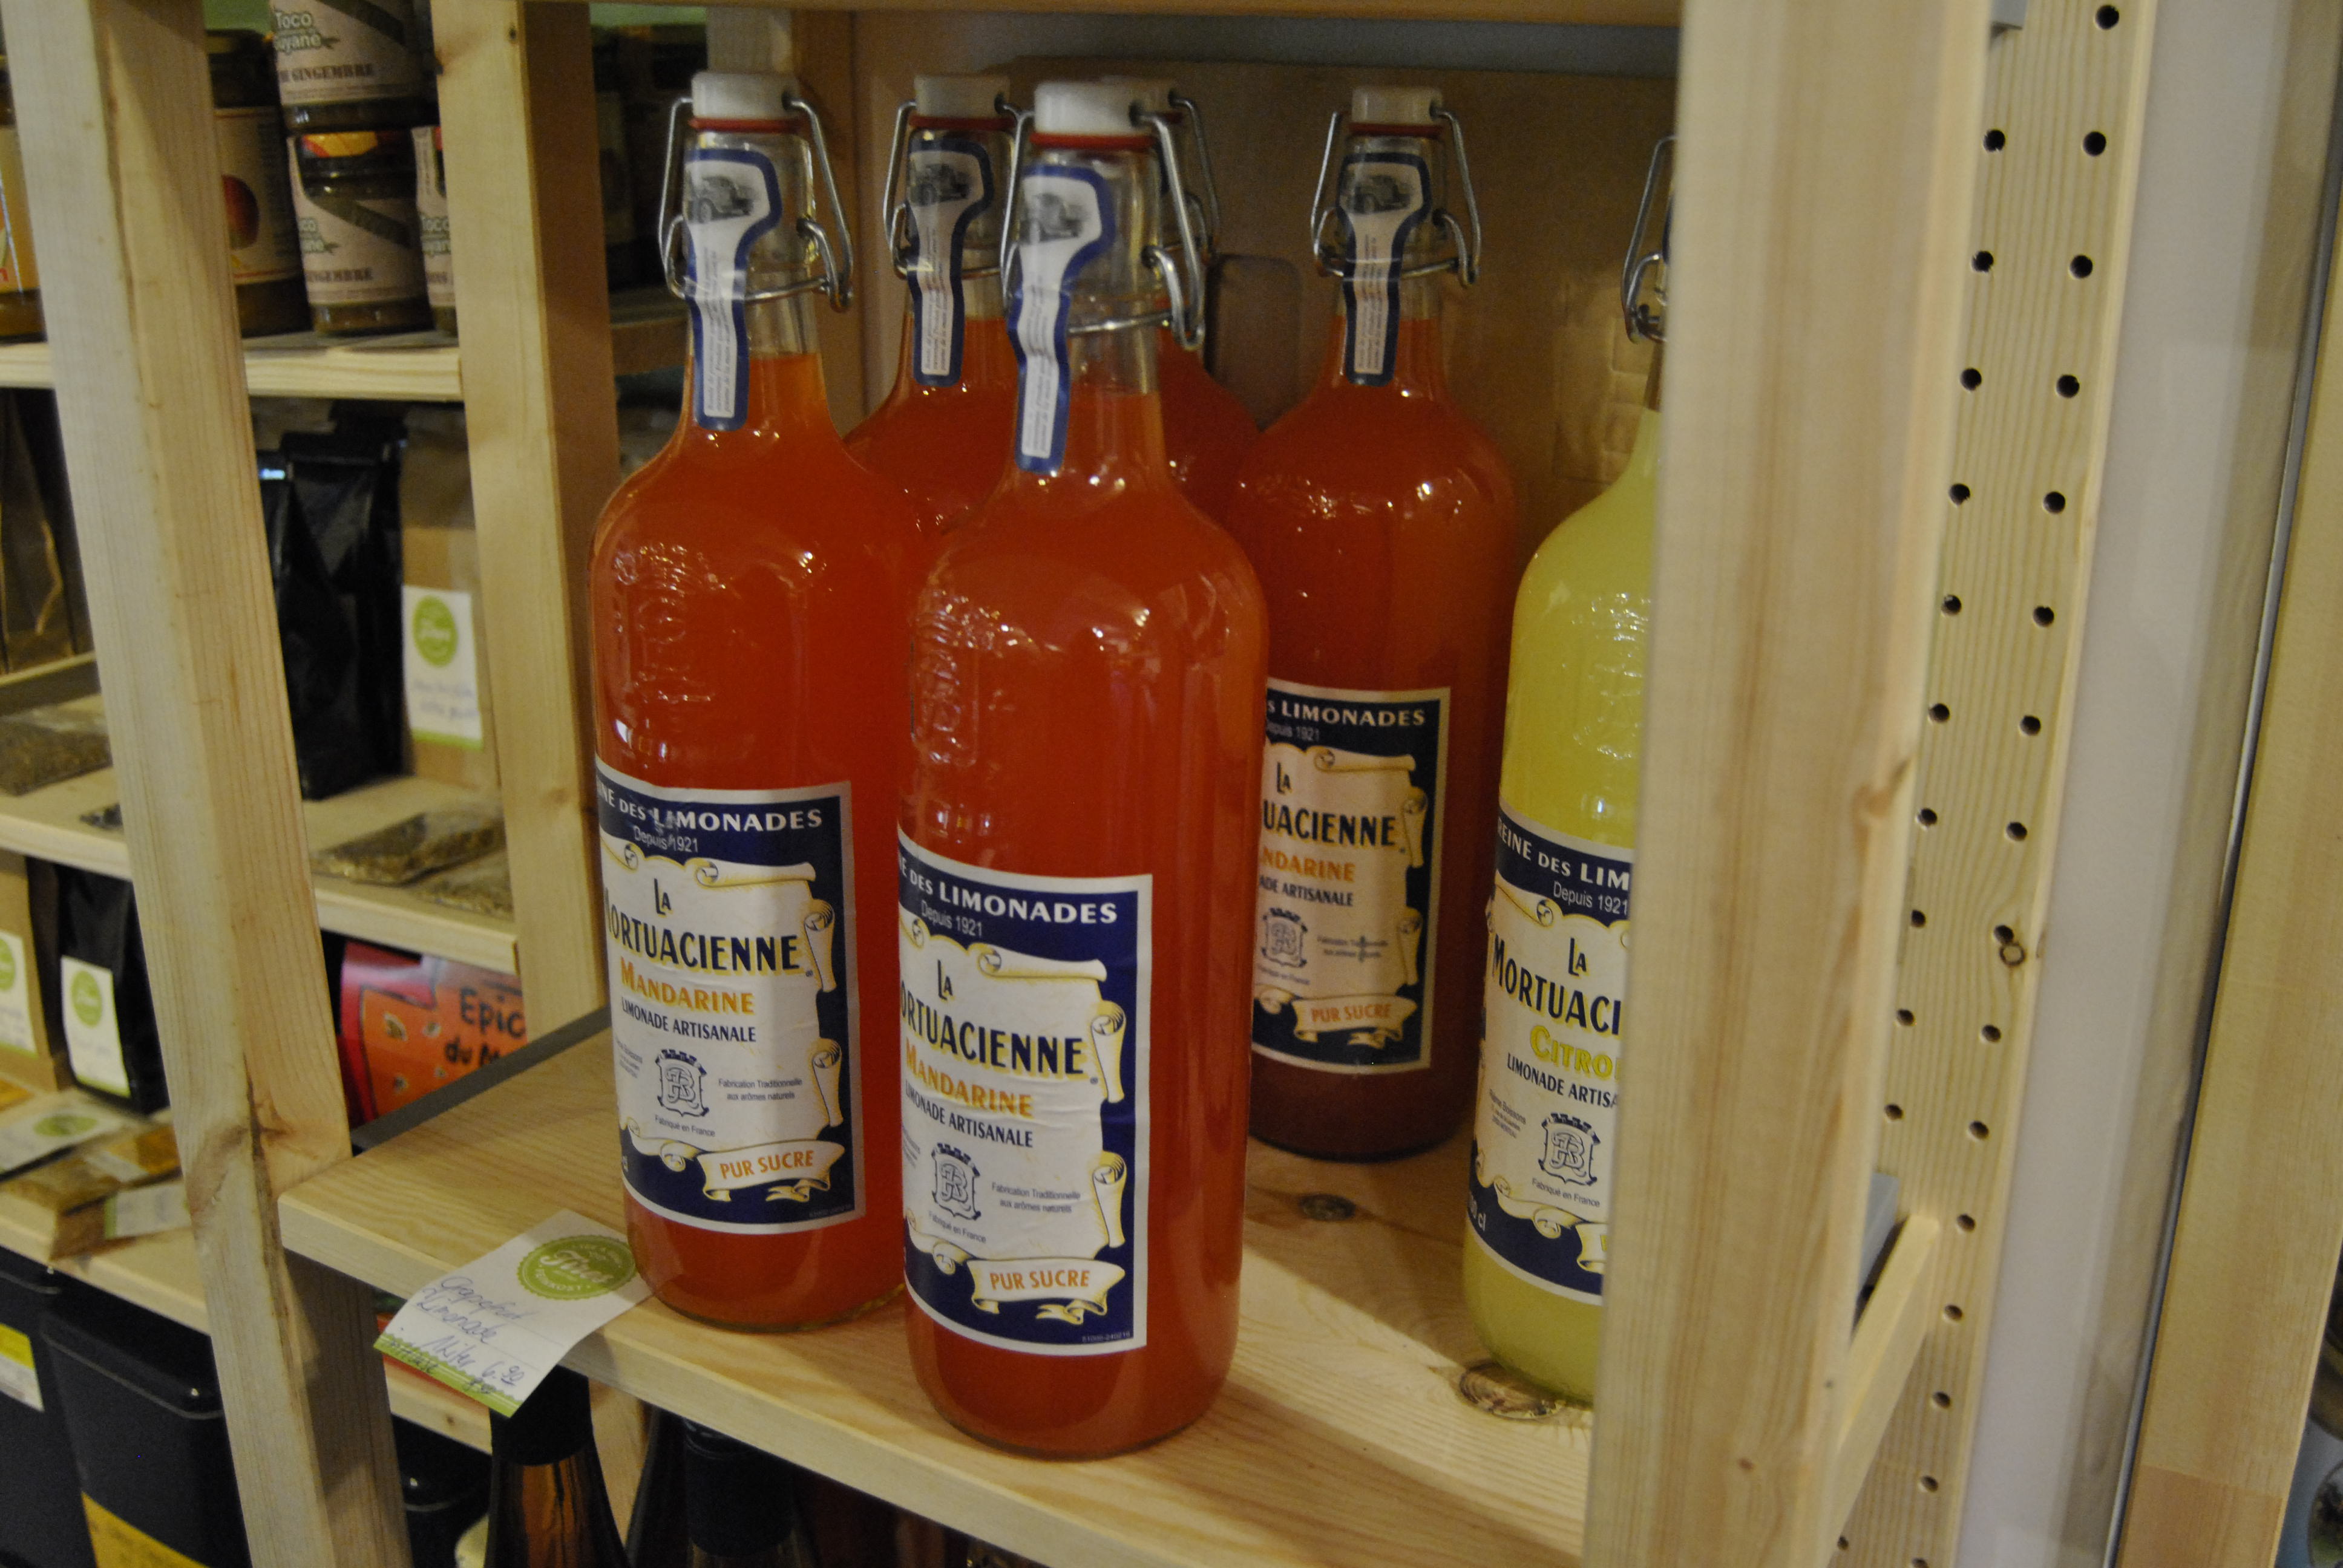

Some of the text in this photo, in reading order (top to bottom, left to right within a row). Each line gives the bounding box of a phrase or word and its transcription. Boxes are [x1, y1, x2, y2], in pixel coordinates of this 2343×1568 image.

[1281, 699, 1425, 727] LIMONADES
[619, 798, 647, 822] DES
[653, 807, 823, 832] LIMONADES
[1263, 799, 1396, 846] UACIENNE
[672, 834, 699, 853] 1921
[1538, 851, 1571, 877] DES
[1580, 862, 1630, 892] LIM
[909, 868, 933, 895] DES
[939, 881, 1118, 925] LIMONADES
[1282, 882, 1354, 907] ARTISANALE
[1553, 880, 1628, 916] Depuis 1921
[920, 899, 983, 938] Depuis 1921
[620, 956, 756, 1014] MANDARINE
[1492, 933, 1622, 1036] MORTUACI
[621, 996, 756, 1042] LIMONADE ARTISANALE
[1311, 1003, 1392, 1023] PUR SUCRE
[1530, 1025, 1620, 1081] CITRO
[718, 1077, 803, 1088] Fabrication Traditionnelle
[905, 1036, 1035, 1119] MANDARINE
[1506, 1052, 1565, 1096] LIMONADE
[691, 1125, 716, 1137] France
[905, 1079, 946, 1124] LIMONADE
[949, 1111, 1034, 1148] ARTISANALE
[719, 1150, 815, 1180] PUR SUCRE
[991, 1181, 1081, 1200] Fabrication Traditionnelle
[1531, 1177, 1601, 1208] Fabriqué en France
[953, 1226, 962, 1235] en
[962, 1228, 987, 1244] France
[989, 1269, 1090, 1291] PUR SUCRE
